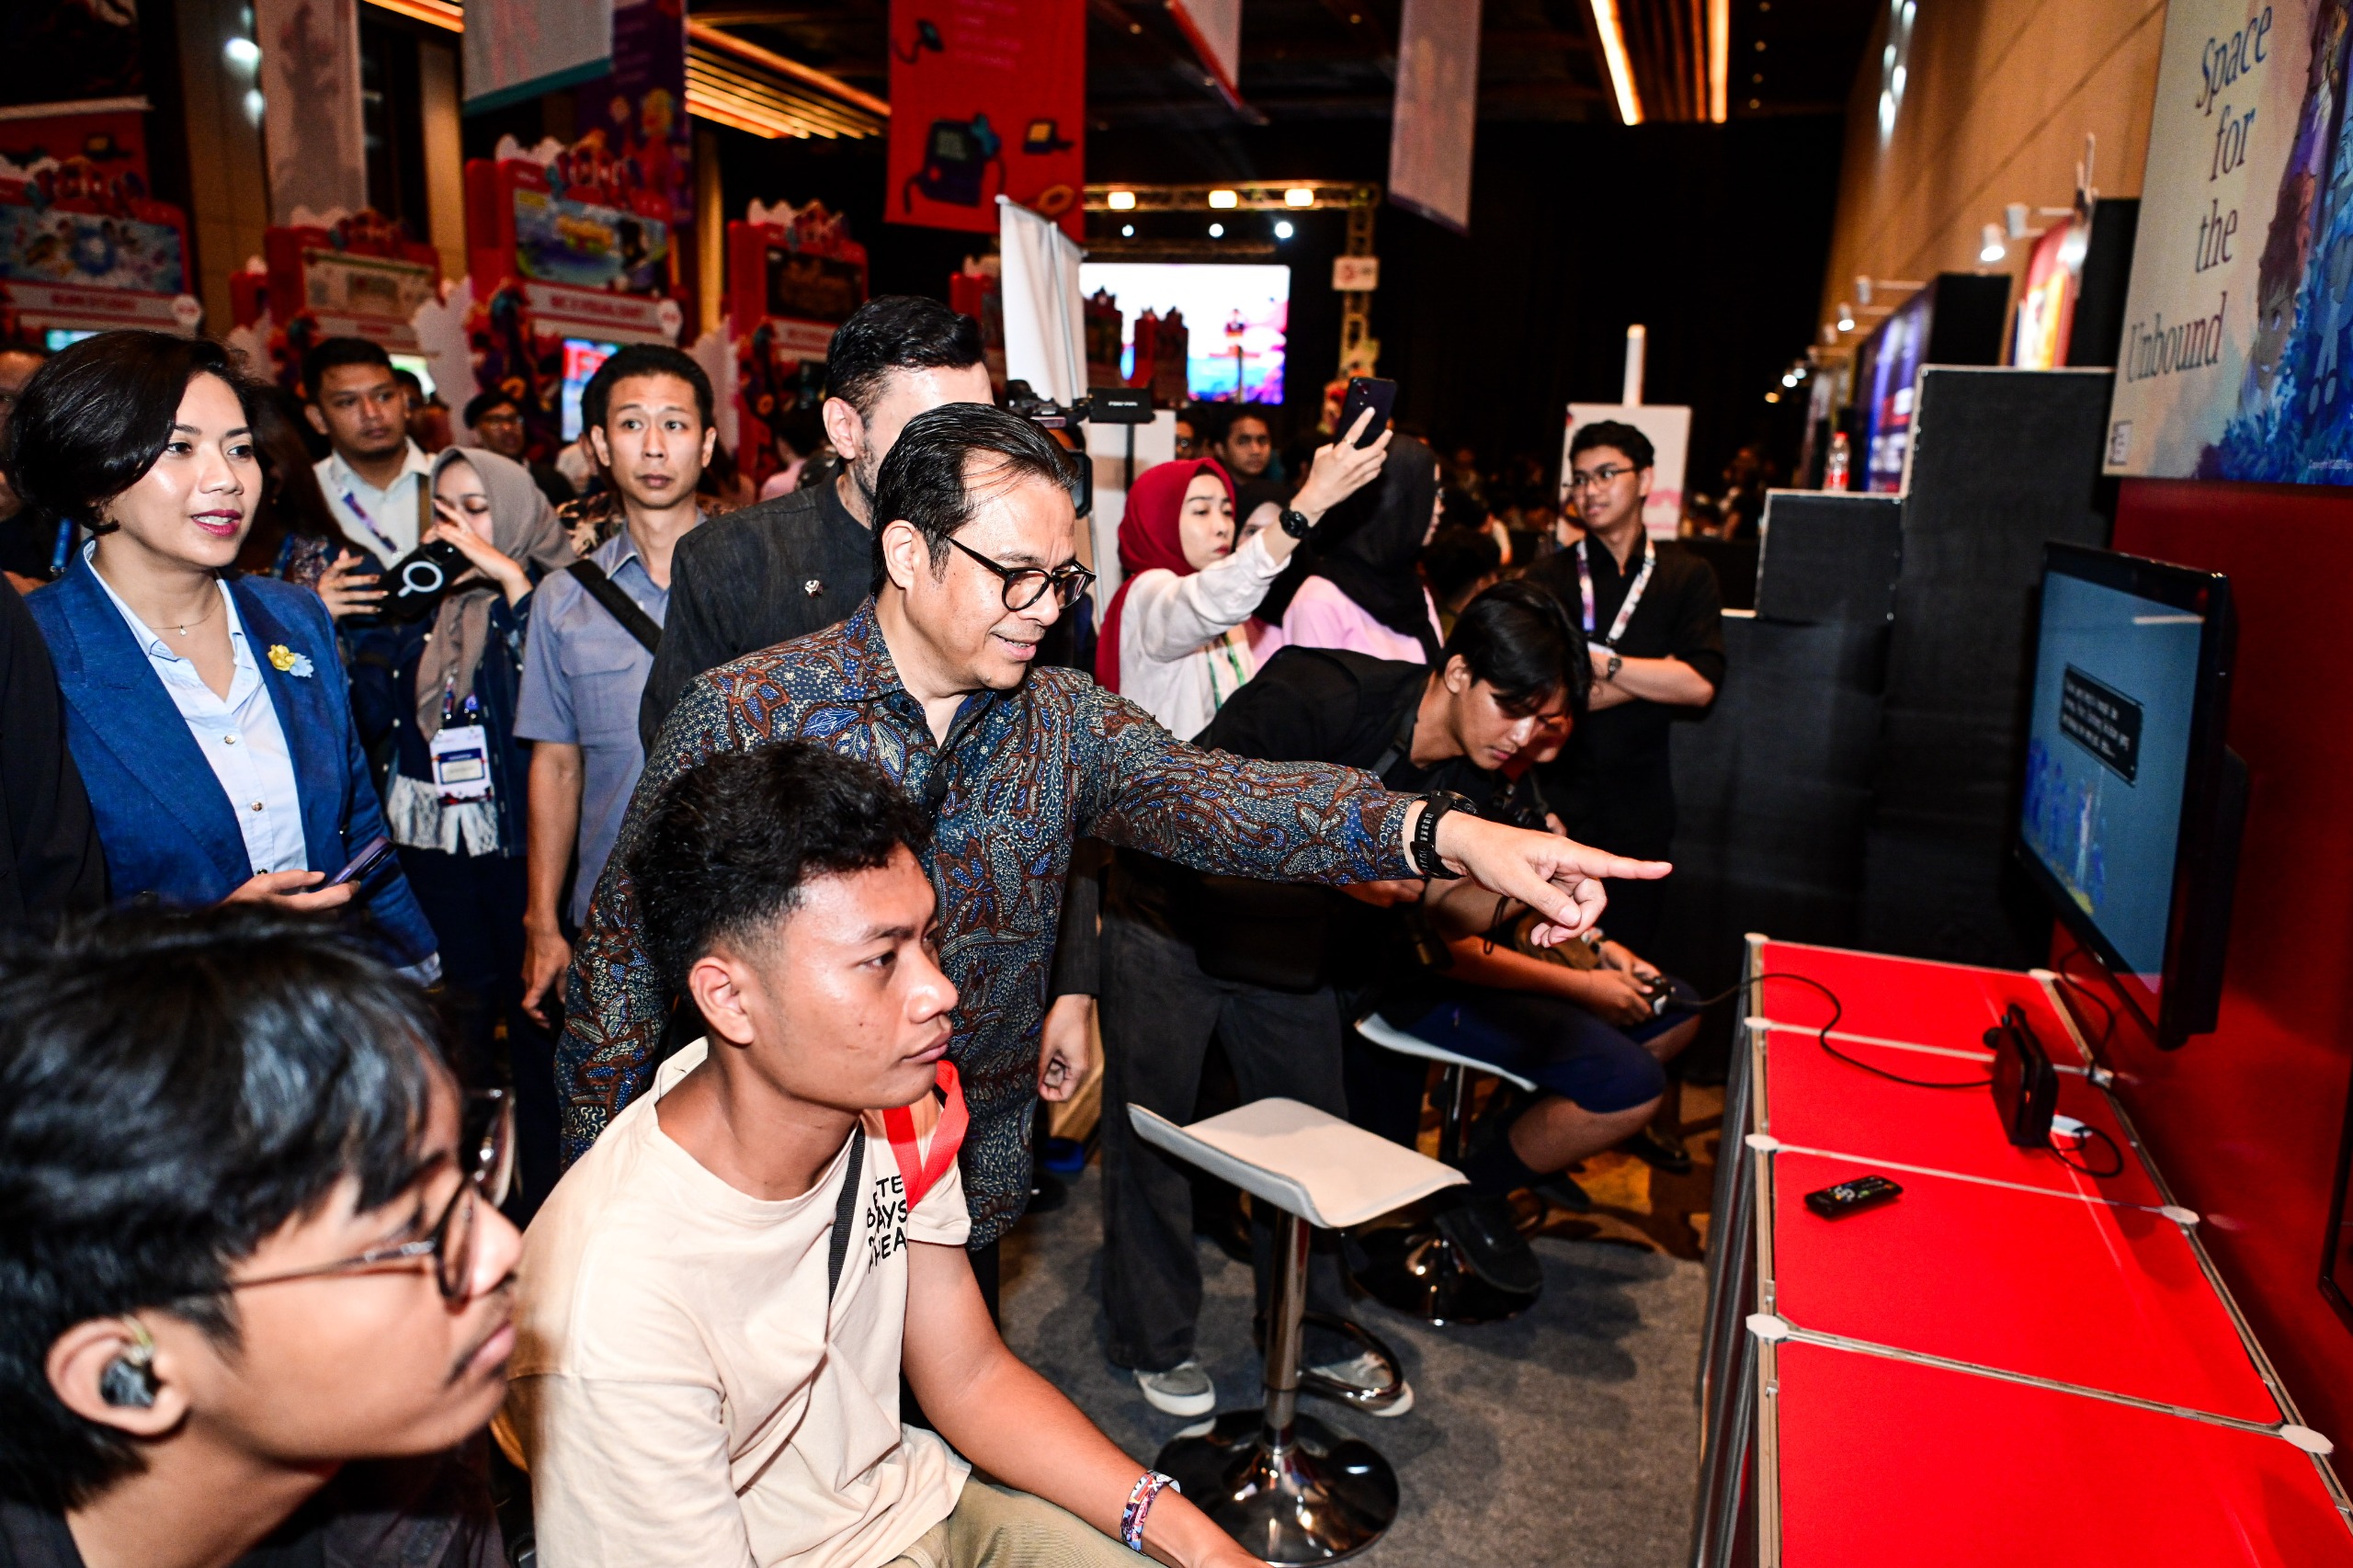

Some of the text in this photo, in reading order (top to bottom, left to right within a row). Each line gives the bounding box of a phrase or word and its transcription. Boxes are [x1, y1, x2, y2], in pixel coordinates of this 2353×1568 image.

[2195, 6, 2273, 117] Space
[2209, 104, 2256, 182] for
[2196, 198, 2238, 273] the
[2127, 290, 2228, 382] Unbound
